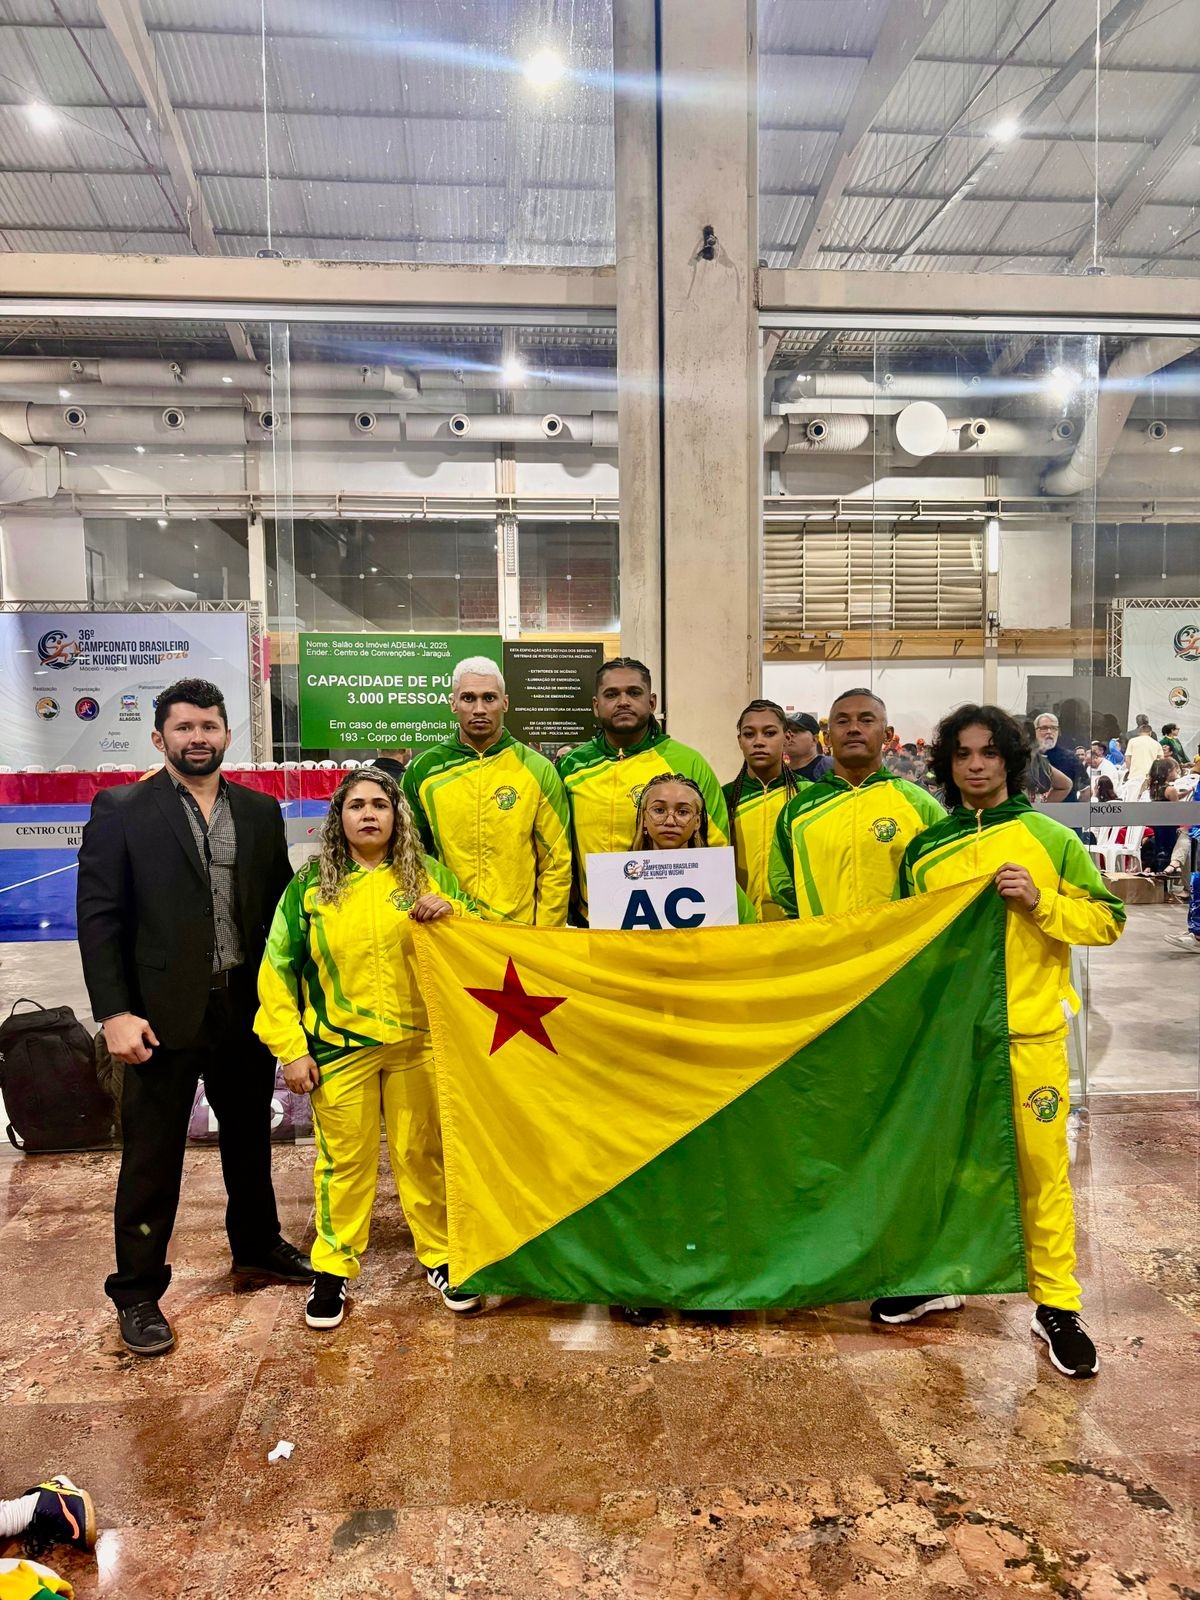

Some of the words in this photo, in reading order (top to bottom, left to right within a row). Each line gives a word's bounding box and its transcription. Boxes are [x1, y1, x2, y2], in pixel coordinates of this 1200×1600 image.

[79, 630, 95, 640] 36º
[79, 641, 137, 652] CAMPEONATO
[140, 641, 189, 652] BRASILEIRO
[79, 655, 90, 665] DE
[93, 654, 127, 665] KUNGFU
[130, 654, 160, 665] WUSHU
[160, 652, 188, 661] 2026
[371, 650, 415, 658] Convenções
[422, 650, 452, 658] Jaraguá.
[307, 675, 403, 687] CAPACIDADE
[408, 676, 427, 687] DE
[432, 673, 454, 687] PÚ
[348, 693, 384, 704] 3.000
[330, 720, 346, 729] Em
[375, 720, 388, 729] de
[391, 720, 447, 731] emergência
[340, 733, 358, 741] 193
[368, 733, 397, 743] Corpo
[400, 733, 412, 741] de
[16, 827, 55, 835] CENTRO
[620, 887, 706, 930] AC
